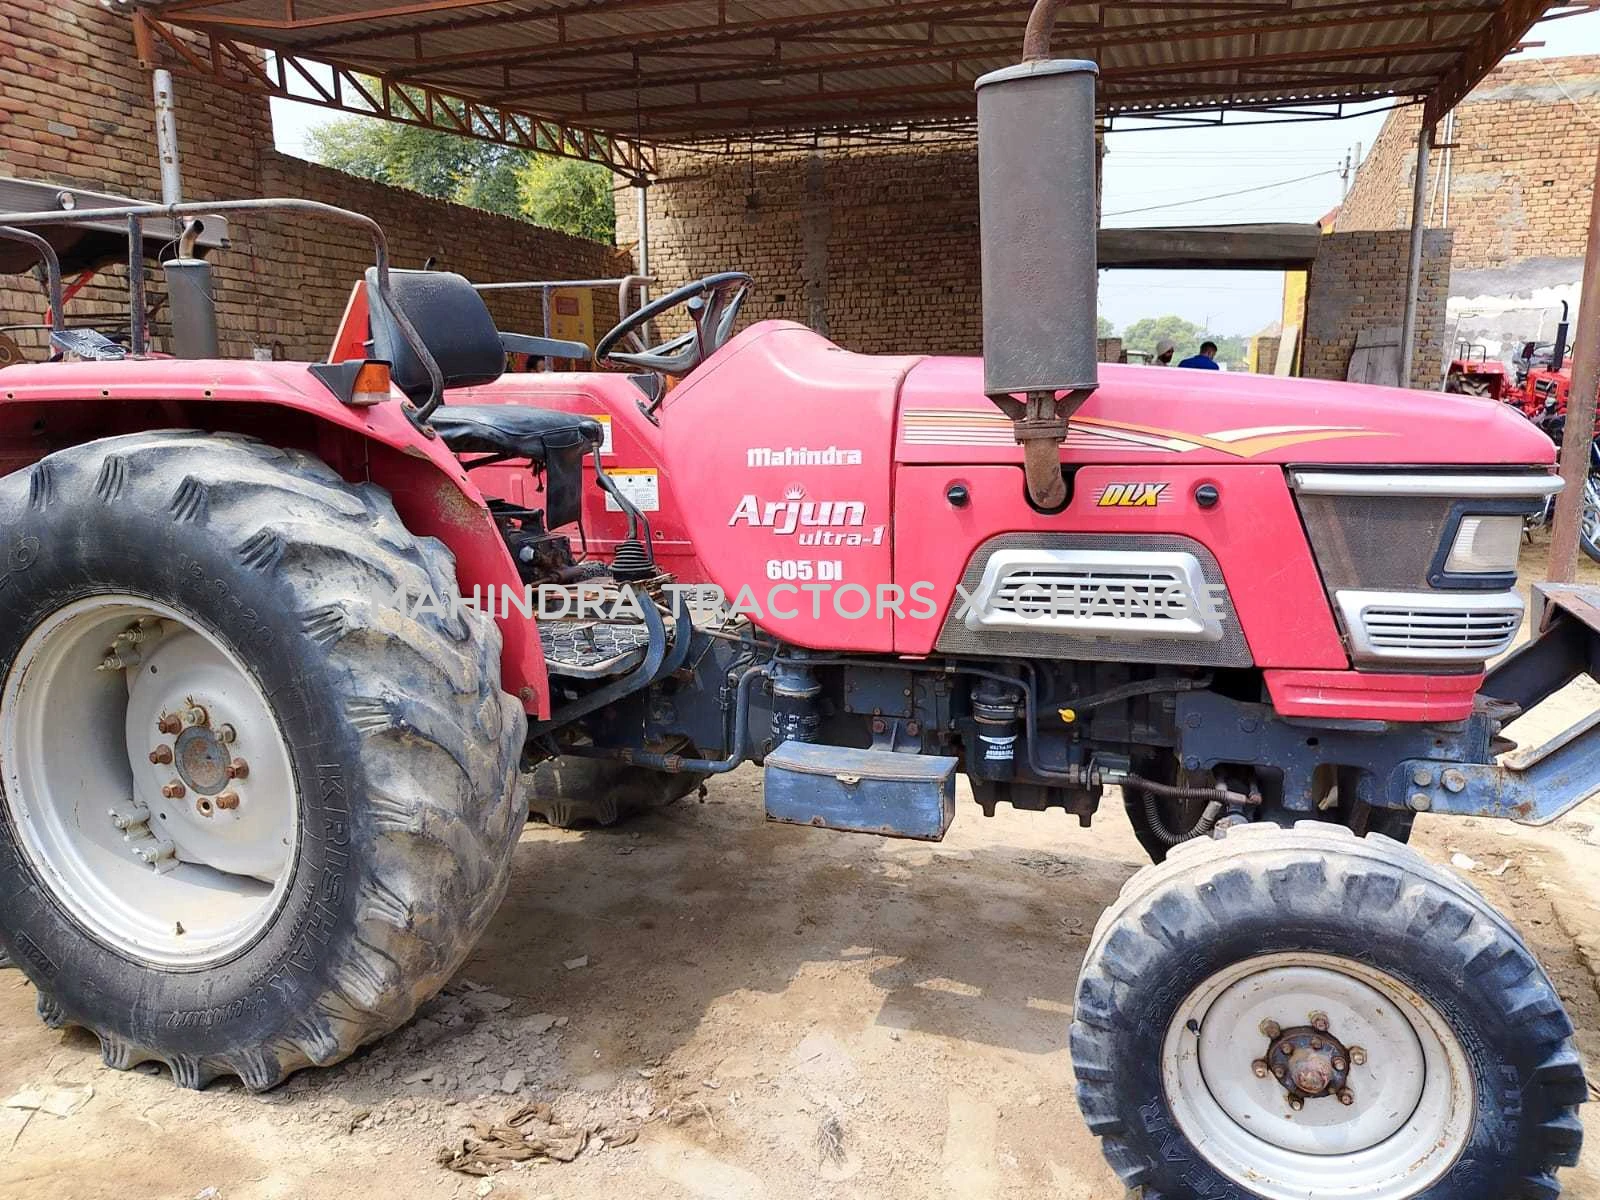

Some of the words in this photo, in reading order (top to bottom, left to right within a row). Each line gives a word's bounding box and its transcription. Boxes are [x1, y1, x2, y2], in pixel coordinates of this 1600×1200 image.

[746, 446, 862, 467] Mahindra
[1097, 483, 1170, 507] DLX
[728, 488, 867, 534] Arjun
[798, 524, 886, 546] ultra-1
[766, 560, 813, 581] 605
[817, 560, 843, 581] DI
[268, 762, 352, 1003] KRISHAK
